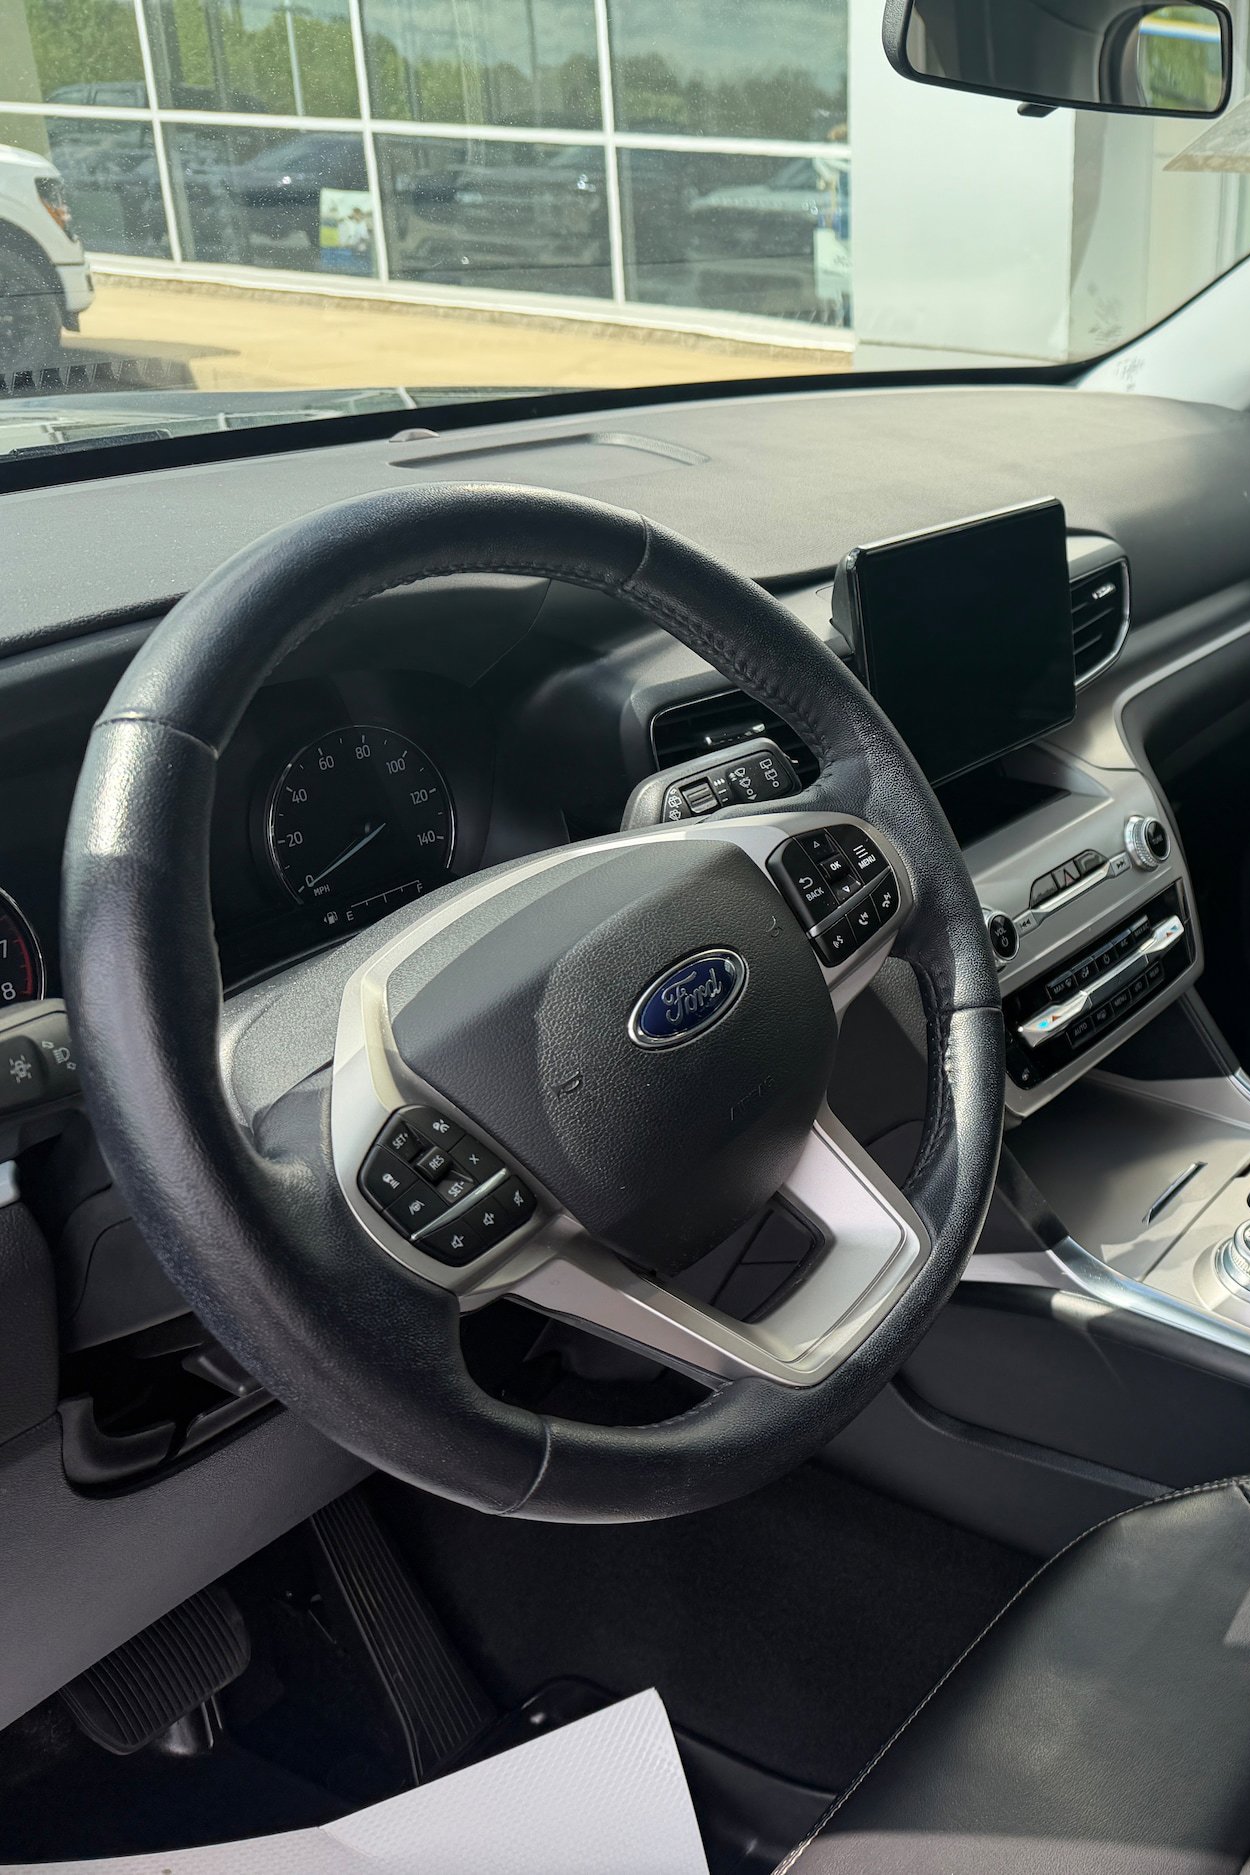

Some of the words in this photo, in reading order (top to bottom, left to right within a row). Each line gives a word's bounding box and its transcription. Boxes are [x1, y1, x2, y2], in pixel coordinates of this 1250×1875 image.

[355, 745, 371, 759] 80
[318, 755, 335, 770] 60
[386, 757, 406, 774] 100
[291, 788, 307, 804] 40
[410, 789, 428, 805] 120
[286, 831, 303, 847] 20
[417, 830, 436, 846] 140
[830, 861, 842, 871] OK
[858, 855, 876, 869] MENU
[305, 875, 314, 888] 0
[416, 883, 423, 893] F
[313, 884, 330, 897] MPH
[806, 887, 824, 902] BACK
[346, 911, 354, 921] E
[1, 982, 17, 1000] 8
[661, 968, 722, 1023] Ford
[1074, 1022, 1088, 1036] AUTO
[392, 1133, 409, 1149] SET+
[429, 1155, 445, 1171] RES
